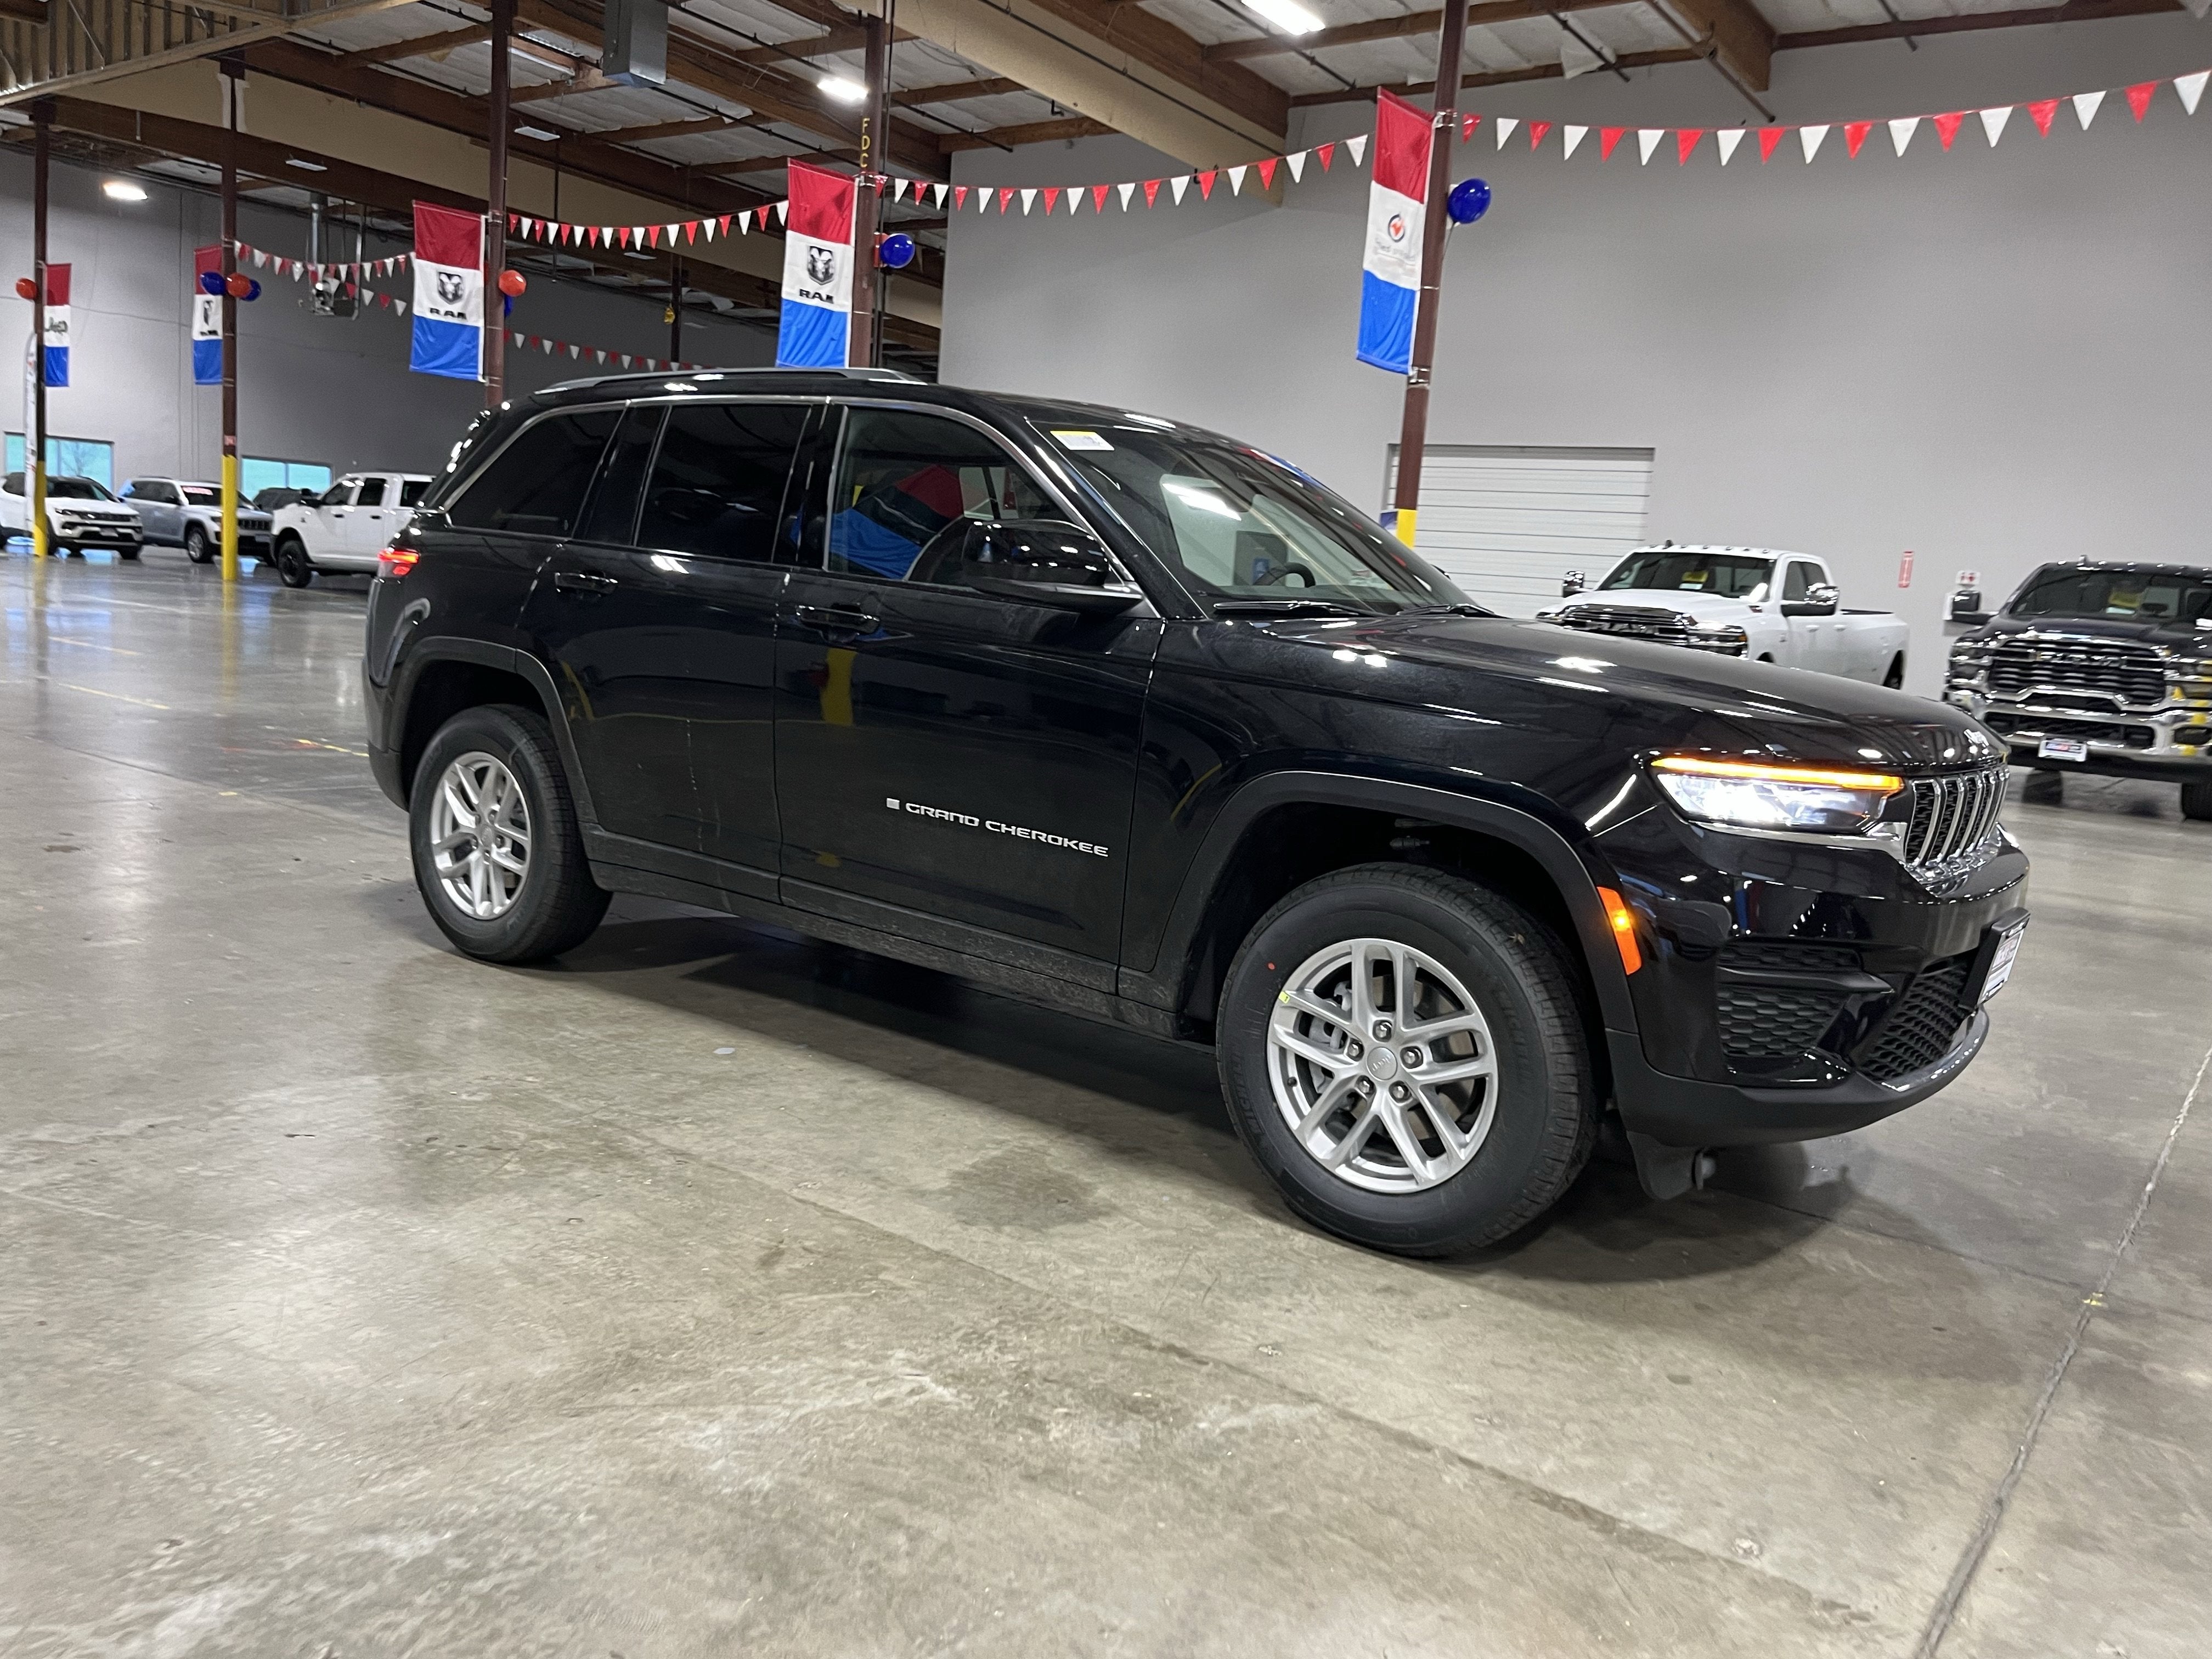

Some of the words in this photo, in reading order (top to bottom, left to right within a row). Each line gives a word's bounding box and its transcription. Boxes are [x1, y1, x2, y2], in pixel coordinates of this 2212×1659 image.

[860, 117, 871, 168] FDC
[905, 802, 980, 827] GRAND
[985, 820, 1109, 857] CHEROKEE
